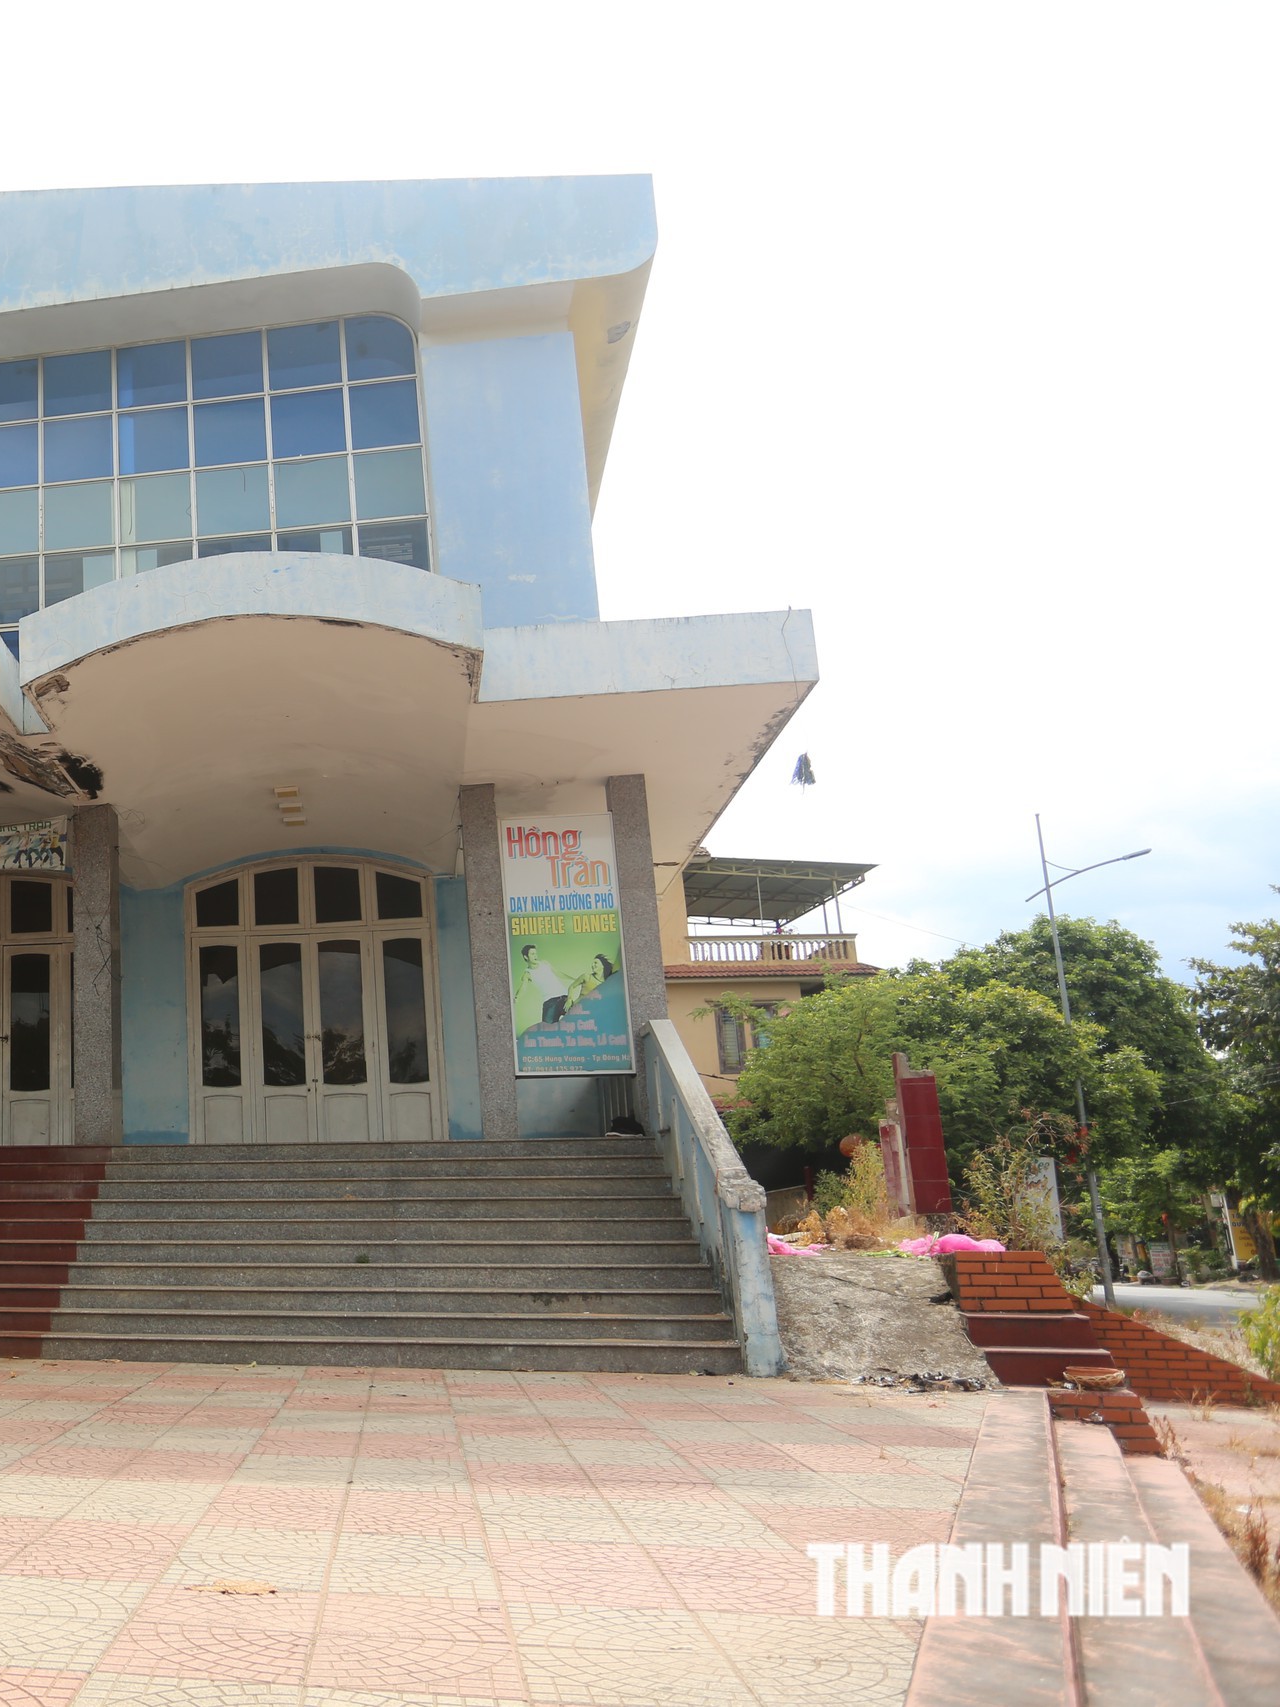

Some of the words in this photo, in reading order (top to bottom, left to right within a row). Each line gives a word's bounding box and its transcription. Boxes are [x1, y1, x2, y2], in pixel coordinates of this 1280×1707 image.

[506, 825, 582, 861] Hồng
[546, 854, 612, 888] Trần
[531, 889, 556, 912] NHẢY
[559, 890, 592, 911] ĐƯỜNG
[594, 886, 614, 909] PHỐ
[511, 916, 565, 935] SHUFFLE
[573, 914, 617, 933] DANCE
